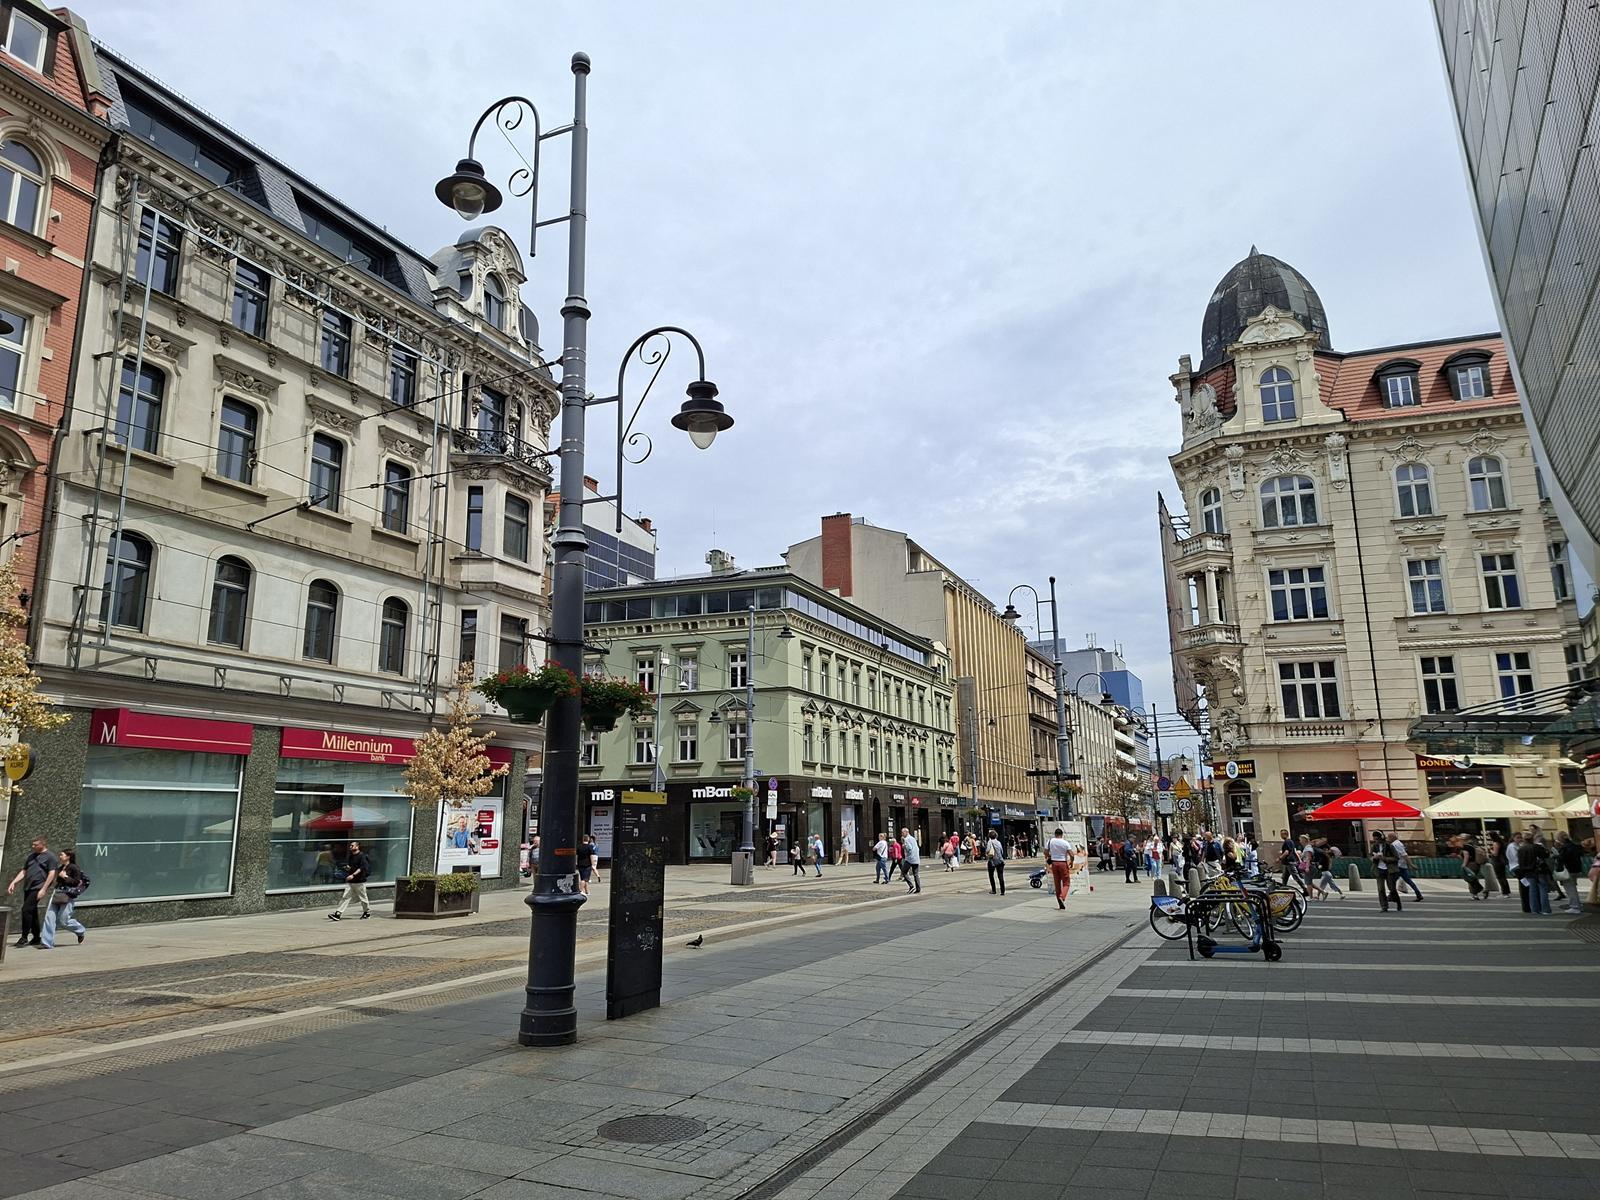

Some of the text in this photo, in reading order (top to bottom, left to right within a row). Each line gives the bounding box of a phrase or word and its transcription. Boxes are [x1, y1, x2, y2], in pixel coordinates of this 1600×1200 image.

[100, 721, 117, 744] M
[321, 731, 393, 753] Millennium
[371, 754, 386, 762] bank
[1419, 759, 1452, 767] DÖNER
[811, 786, 833, 799] mBank
[844, 788, 864, 801] mBank
[1342, 800, 1383, 808] Coca-Cola
[95, 844, 108, 857] M
